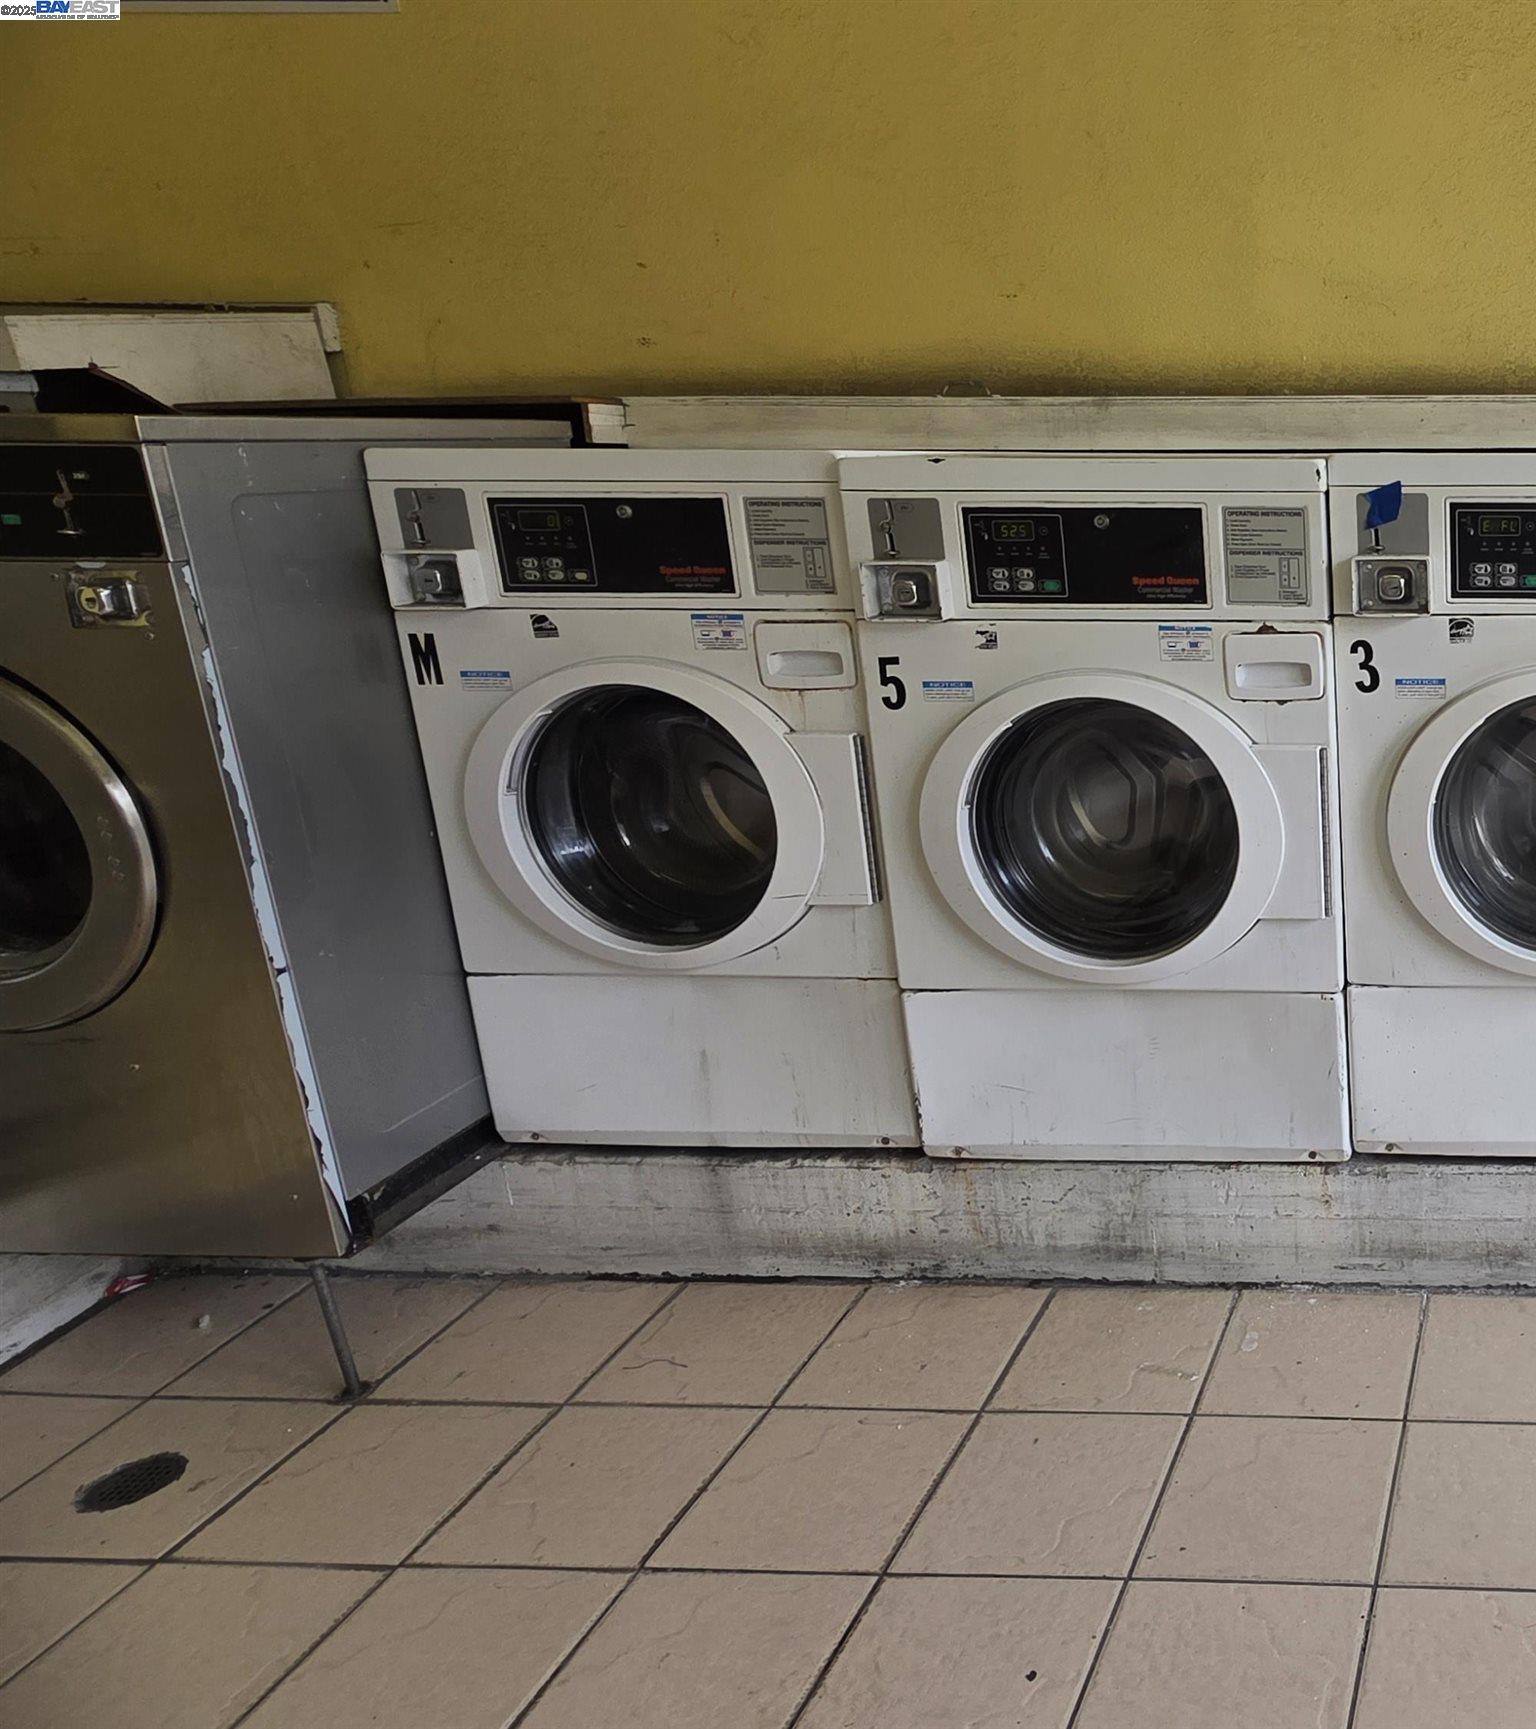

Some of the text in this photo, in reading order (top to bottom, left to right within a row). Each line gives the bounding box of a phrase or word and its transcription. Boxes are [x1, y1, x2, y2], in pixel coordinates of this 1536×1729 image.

[1001, 525, 1026, 537] 525
[1132, 576, 1199, 586] Speed Queen
[408, 633, 444, 685] M
[878, 656, 906, 710] 5
[1350, 639, 1380, 693] 3
